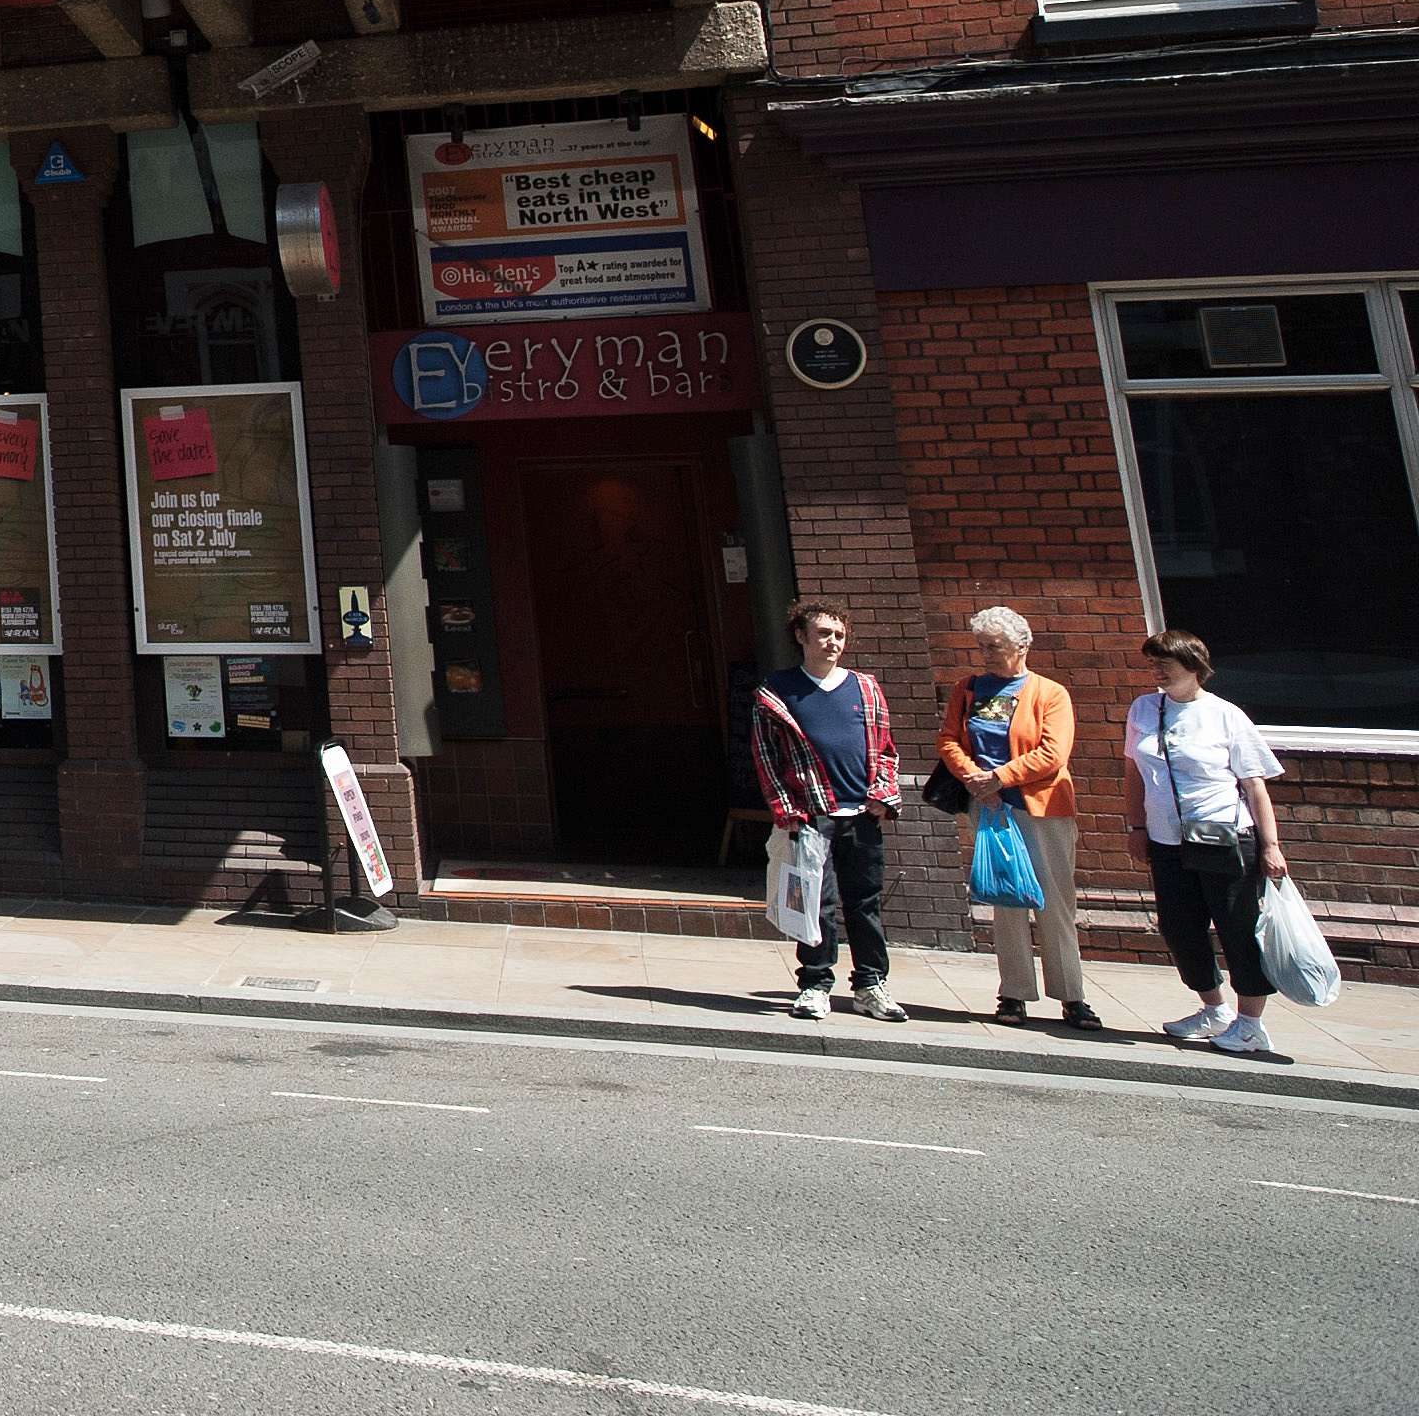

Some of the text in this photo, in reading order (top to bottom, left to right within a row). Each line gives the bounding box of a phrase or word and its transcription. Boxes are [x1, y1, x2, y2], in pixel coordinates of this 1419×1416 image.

[271, 48, 306, 74] SCOPE
[579, 169, 655, 186] cheap
[517, 185, 650, 208] eats in the
[430, 216, 481, 225] NATIONAL
[519, 206, 589, 226] North
[431, 224, 473, 233] AWARDS
[463, 264, 541, 284] Harden's
[559, 264, 574, 275] Top
[603, 261, 627, 272] rating
[630, 258, 667, 268] awarded
[669, 257, 682, 266] for
[493, 280, 533, 294] 2007
[559, 272, 675, 287] great food and atmosphere
[439, 302, 473, 312] London
[476, 302, 483, 310] &
[485, 300, 499, 310] the
[551, 294, 607, 306] authoritative
[609, 292, 657, 303] restaurant
[409, 331, 728, 410] Everyman
[599, 368, 627, 400] &
[151, 490, 220, 508] Join us for
[151, 508, 263, 530] our closing finale
[153, 528, 237, 548] on Sat 2 July
